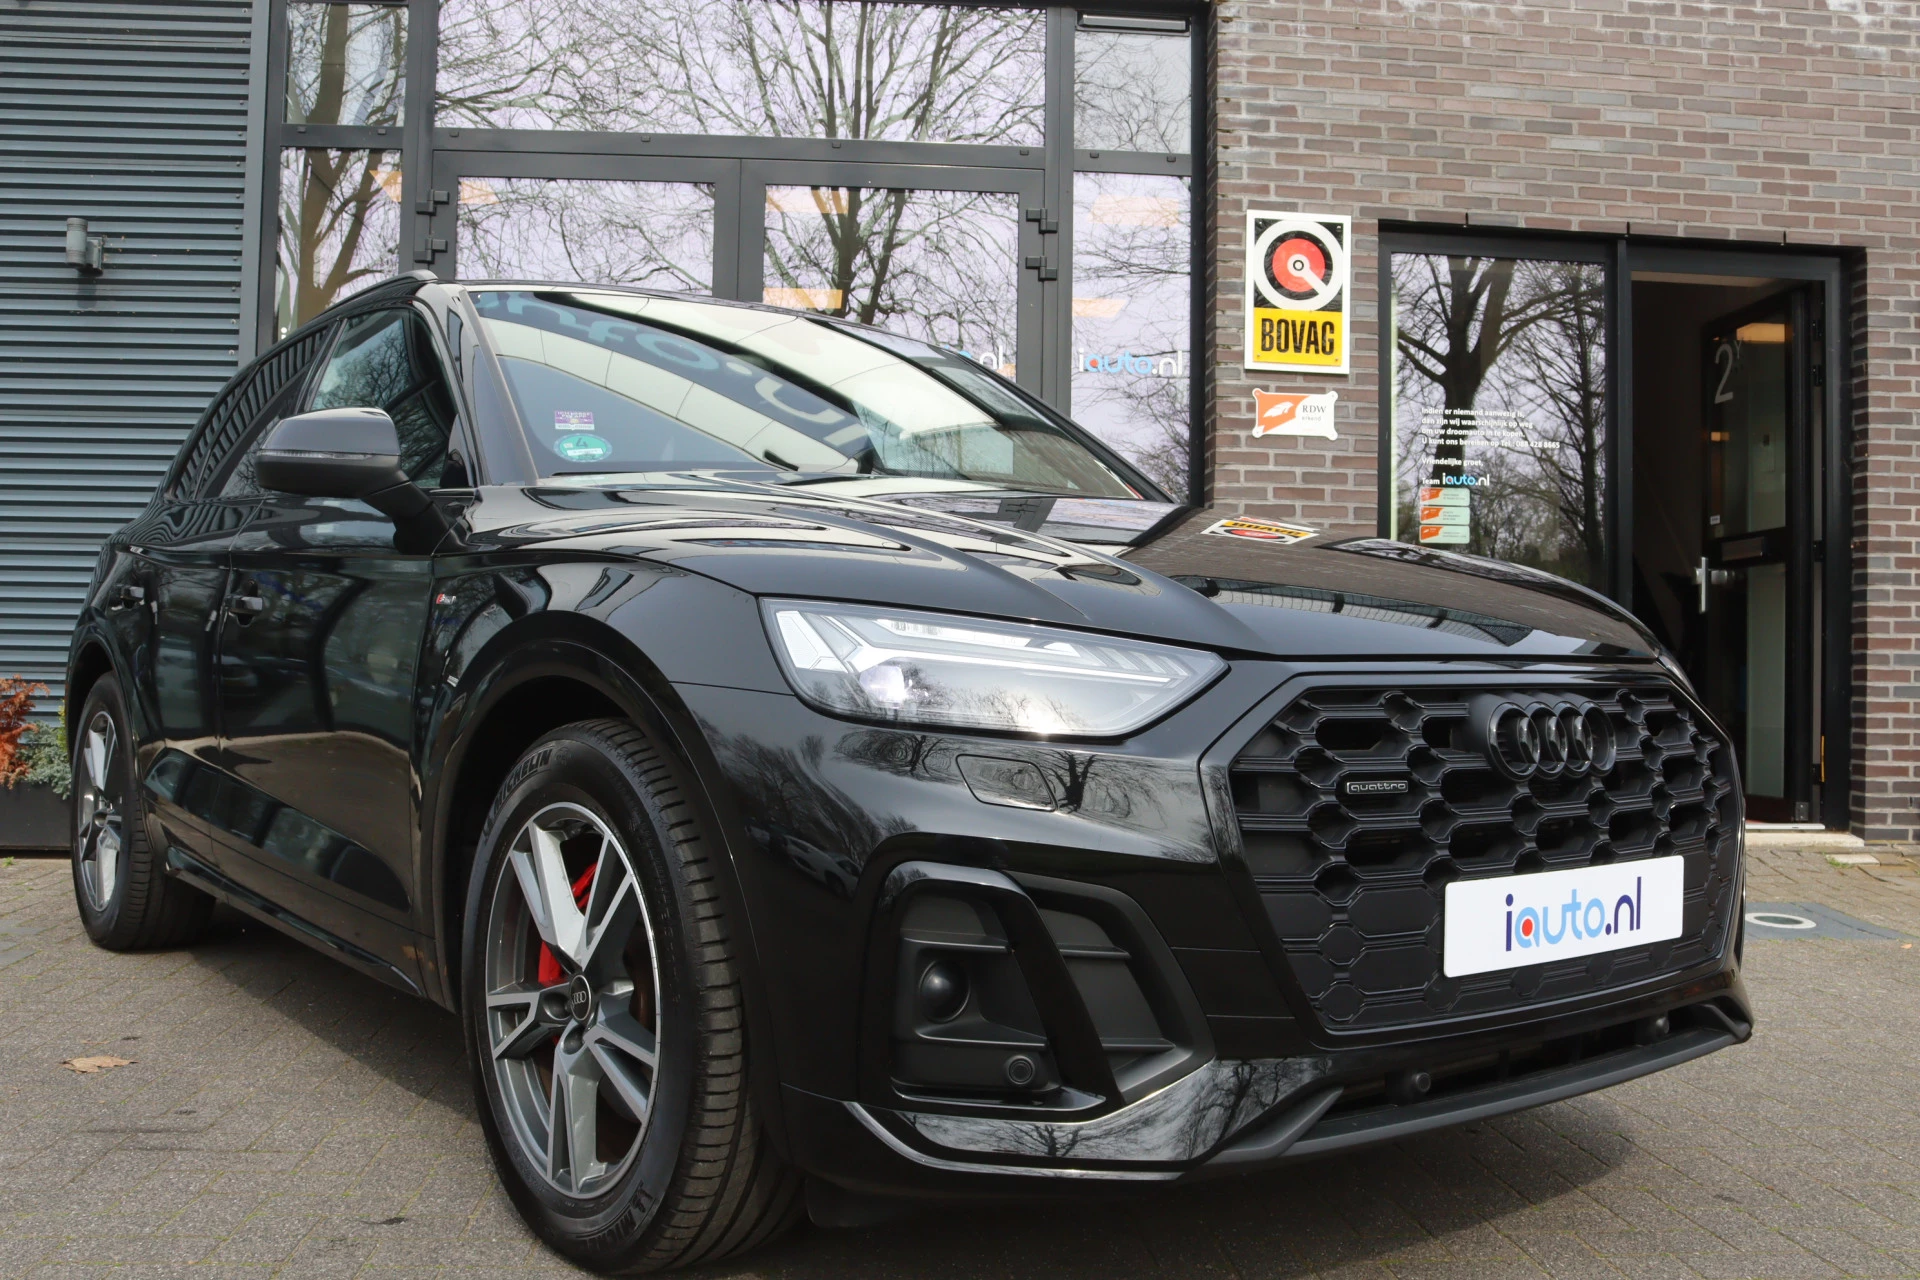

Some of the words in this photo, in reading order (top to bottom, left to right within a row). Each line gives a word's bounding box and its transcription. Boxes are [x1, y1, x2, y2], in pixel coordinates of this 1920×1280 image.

[1261, 318, 1335, 356] BOVAG
[1078, 347, 1183, 375] iauto.nl
[1302, 405, 1326, 413] RDW
[1453, 408, 1483, 416] niemand
[1484, 410, 1515, 418] aanwezig
[1436, 417, 1448, 425] zijn
[1449, 418, 1460, 426] wij
[1461, 419, 1508, 428] waarschijnlijk
[1446, 428, 1485, 436] droomauto
[576, 437, 588, 448] 4
[1428, 437, 1445, 445] kunt
[1459, 438, 1490, 446] bereiken
[1421, 457, 1462, 467] Vriendelijke
[1463, 459, 1484, 467] groet,
[1422, 477, 1440, 485] Team
[1442, 472, 1490, 486] iauto.nl
[493, 748, 553, 815] MICHELIN
[1350, 782, 1407, 793] quattro
[1505, 876, 1642, 952] iauto.nl
